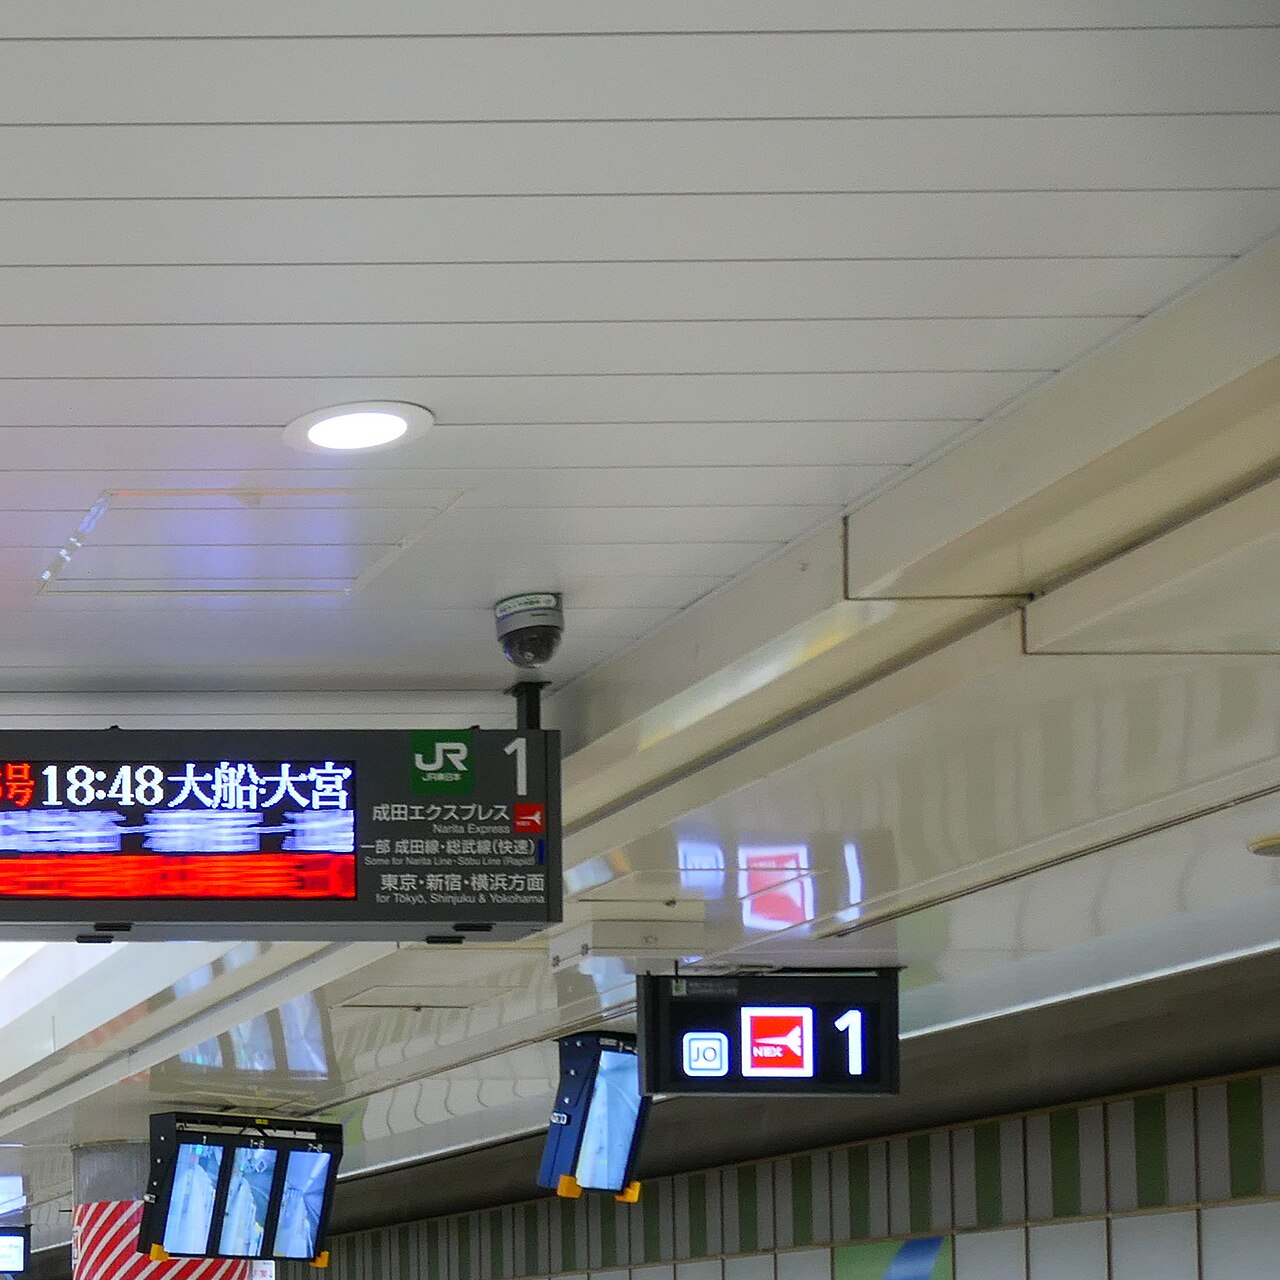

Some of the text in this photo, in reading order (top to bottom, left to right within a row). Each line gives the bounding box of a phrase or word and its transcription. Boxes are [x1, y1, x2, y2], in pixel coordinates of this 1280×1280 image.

[414, 742, 469, 772] JR
[503, 737, 528, 797] 1
[42, 764, 165, 807] 18:48
[372, 803, 511, 822] 成田エクスプレス
[433, 824, 511, 836] Narita Express
[360, 840, 391, 855] 一部
[380, 873, 546, 892] 東京・新宿・横浜方面
[376, 894, 391, 904] for
[430, 893, 476, 906] Shinjuku
[478, 894, 486, 904] &
[490, 894, 546, 904] Yokohama
[833, 1008, 863, 1076] 1
[692, 1047, 718, 1063] JO
